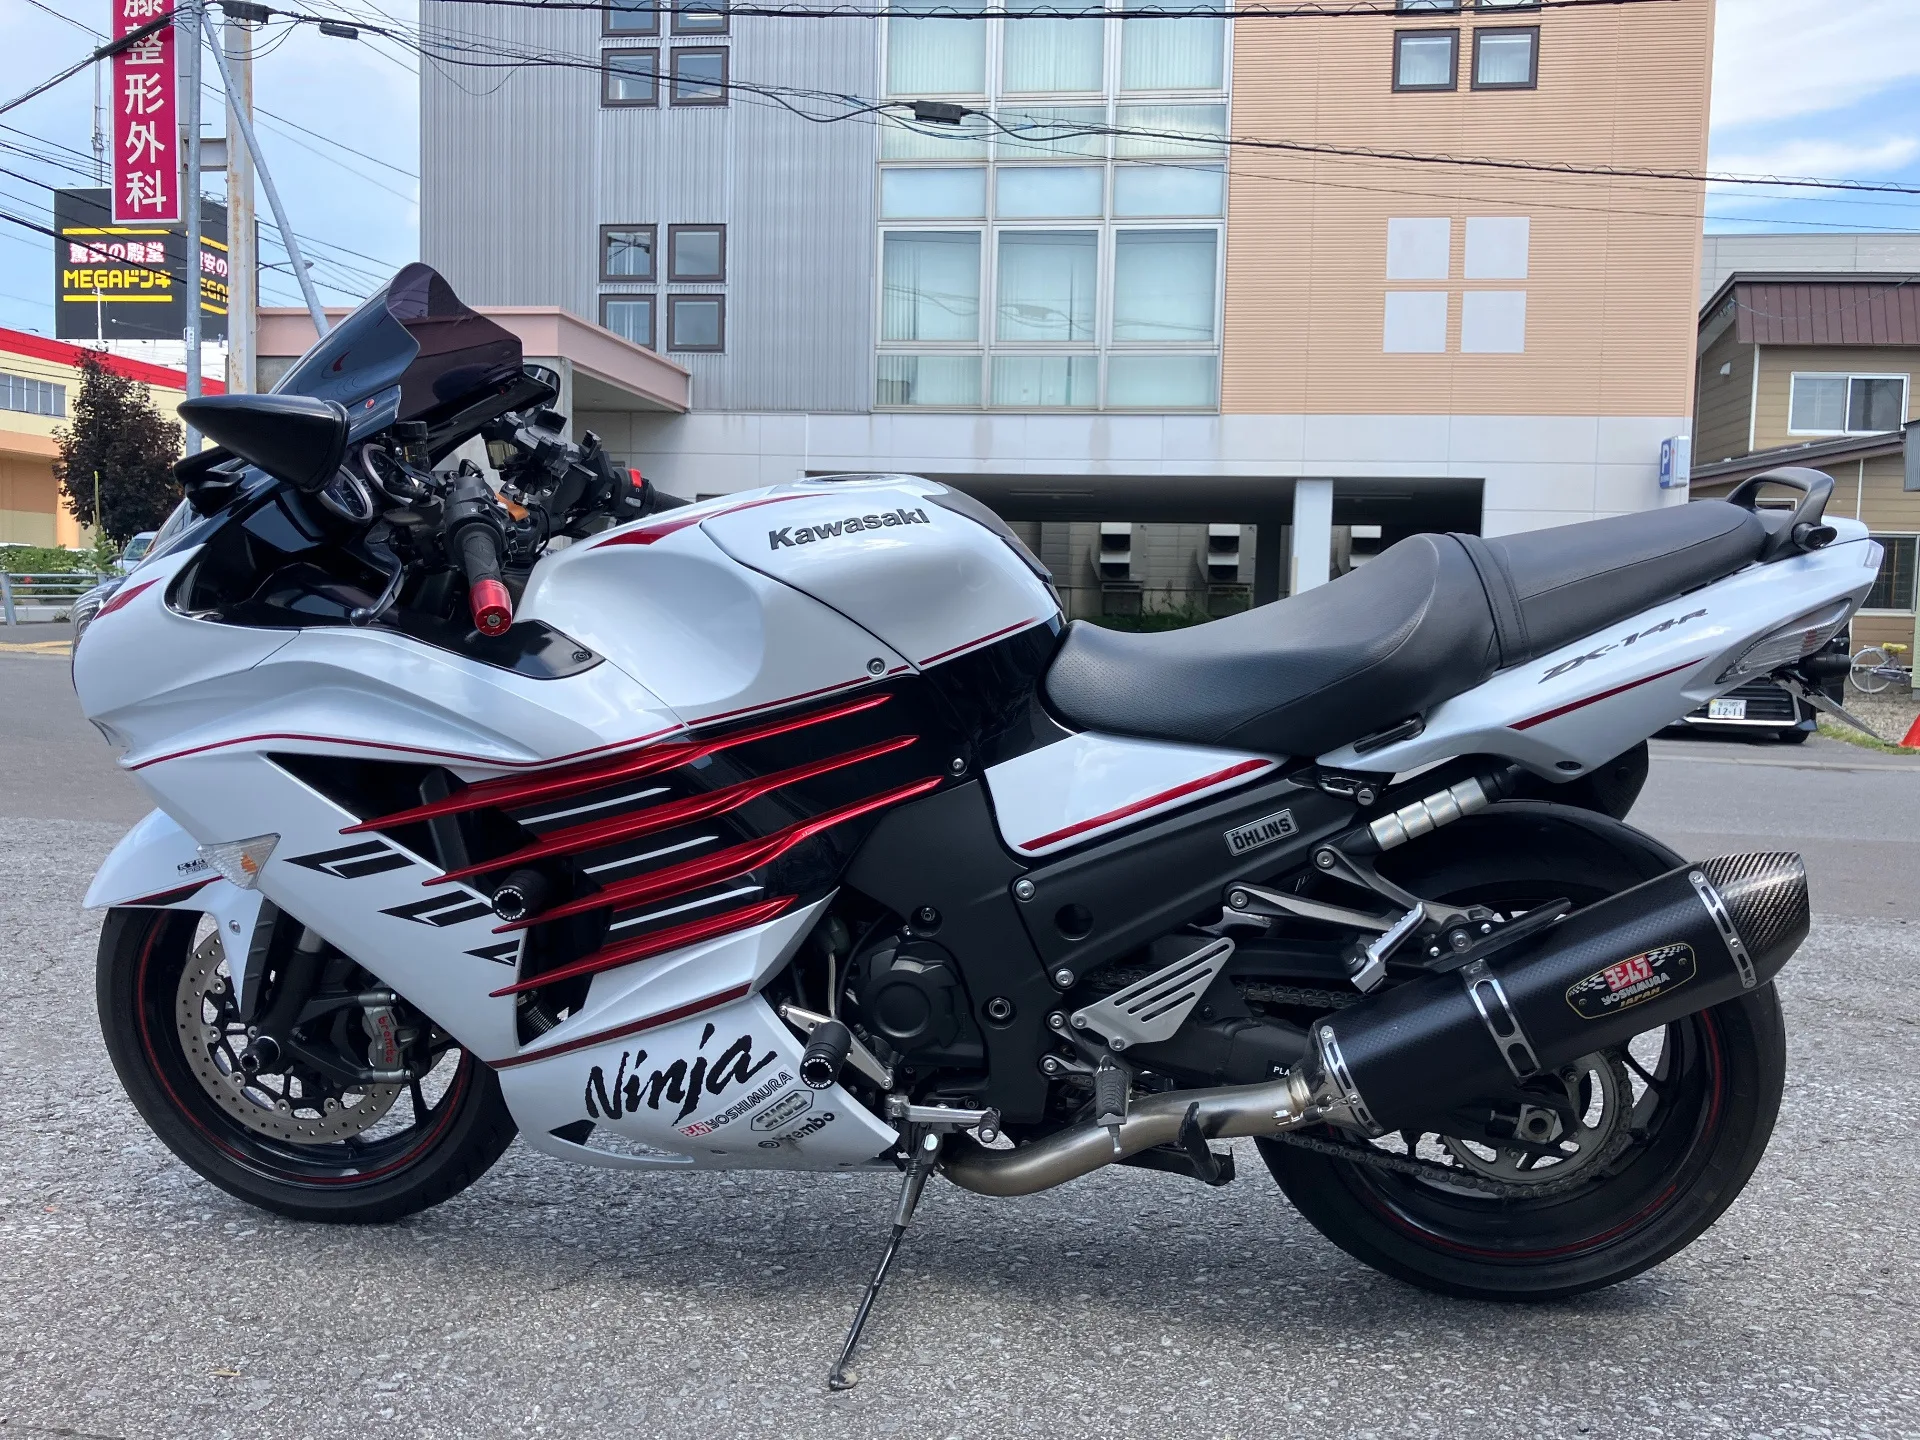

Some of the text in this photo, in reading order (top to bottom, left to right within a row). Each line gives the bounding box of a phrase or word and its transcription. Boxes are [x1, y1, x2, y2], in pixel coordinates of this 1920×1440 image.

[200, 250, 228, 277] 安の
[768, 508, 930, 550] Kawasaki
[1231, 818, 1292, 850] ÖHLINS
[1601, 972, 1670, 1006] YOSHIMURA
[1620, 986, 1661, 1008] JAPAN
[584, 1022, 778, 1127] Ninja
[704, 1071, 794, 1130] YOSHIMURA
